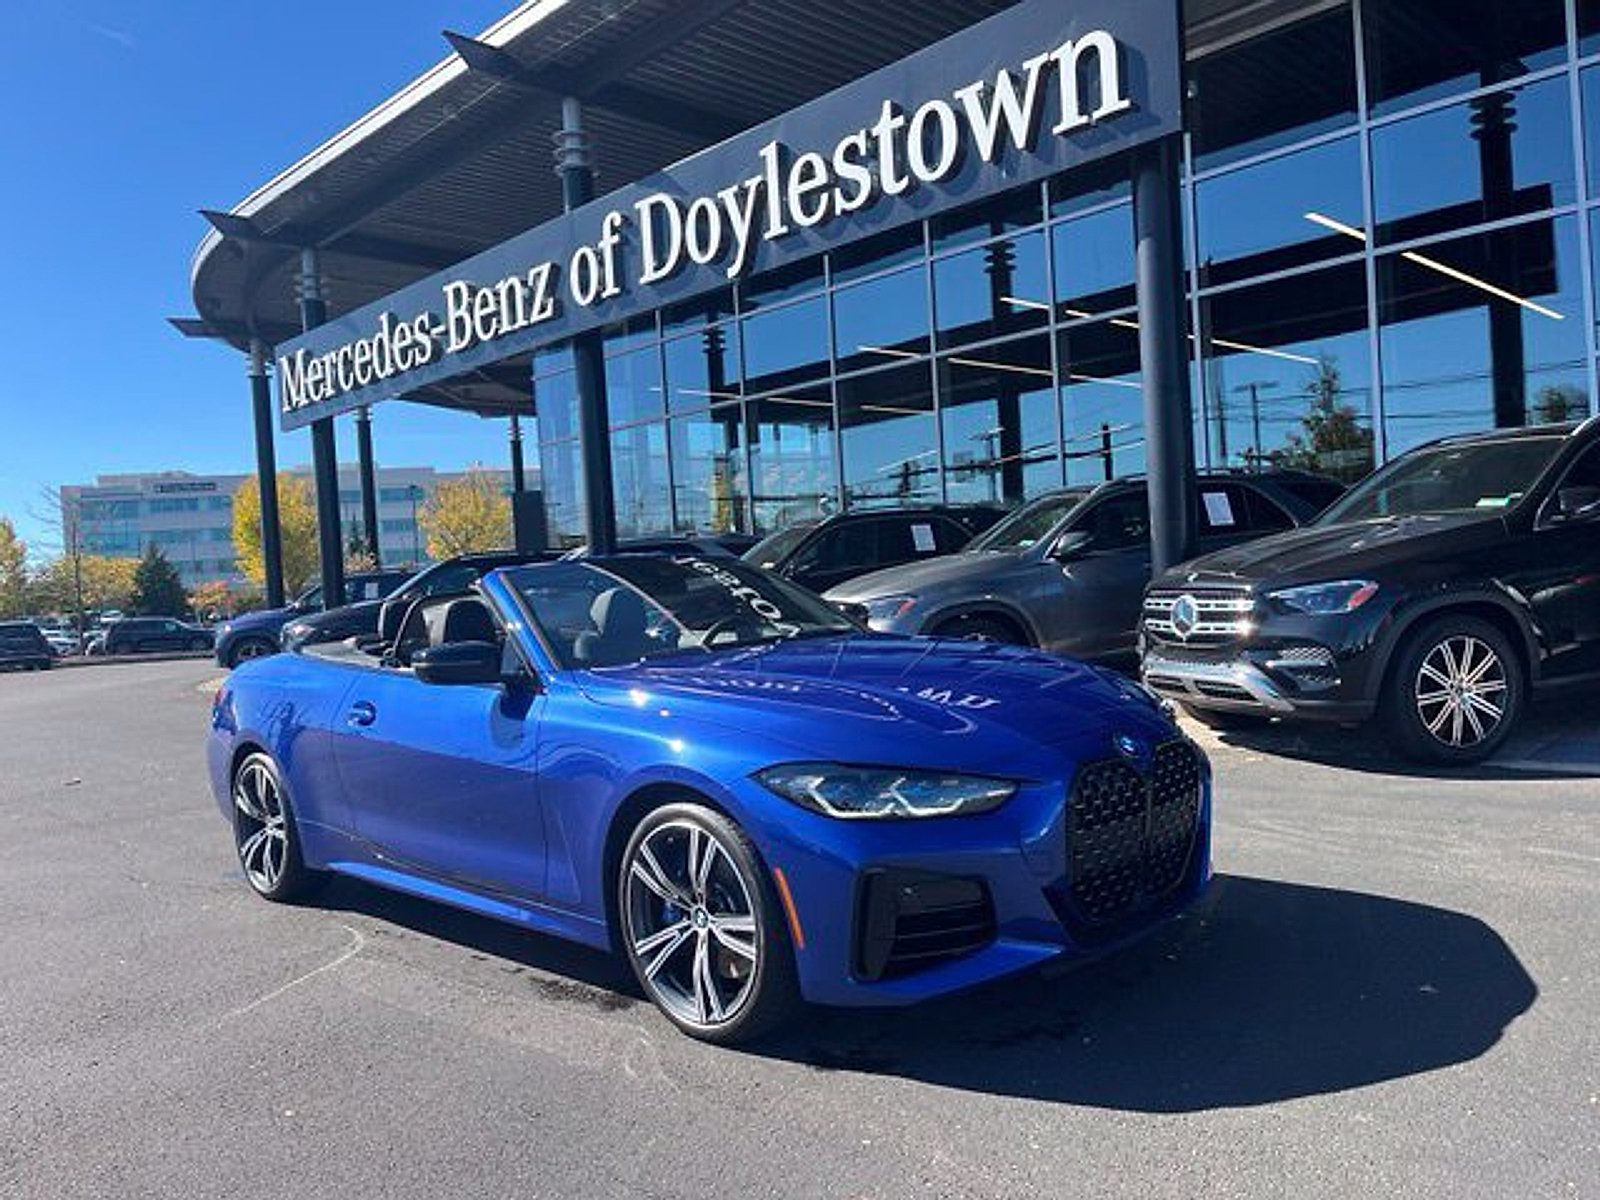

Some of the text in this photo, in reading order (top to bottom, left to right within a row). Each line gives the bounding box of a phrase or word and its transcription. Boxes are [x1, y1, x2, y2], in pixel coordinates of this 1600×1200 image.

[279, 29, 1131, 412] Mercedes-Benz of Doylestown
